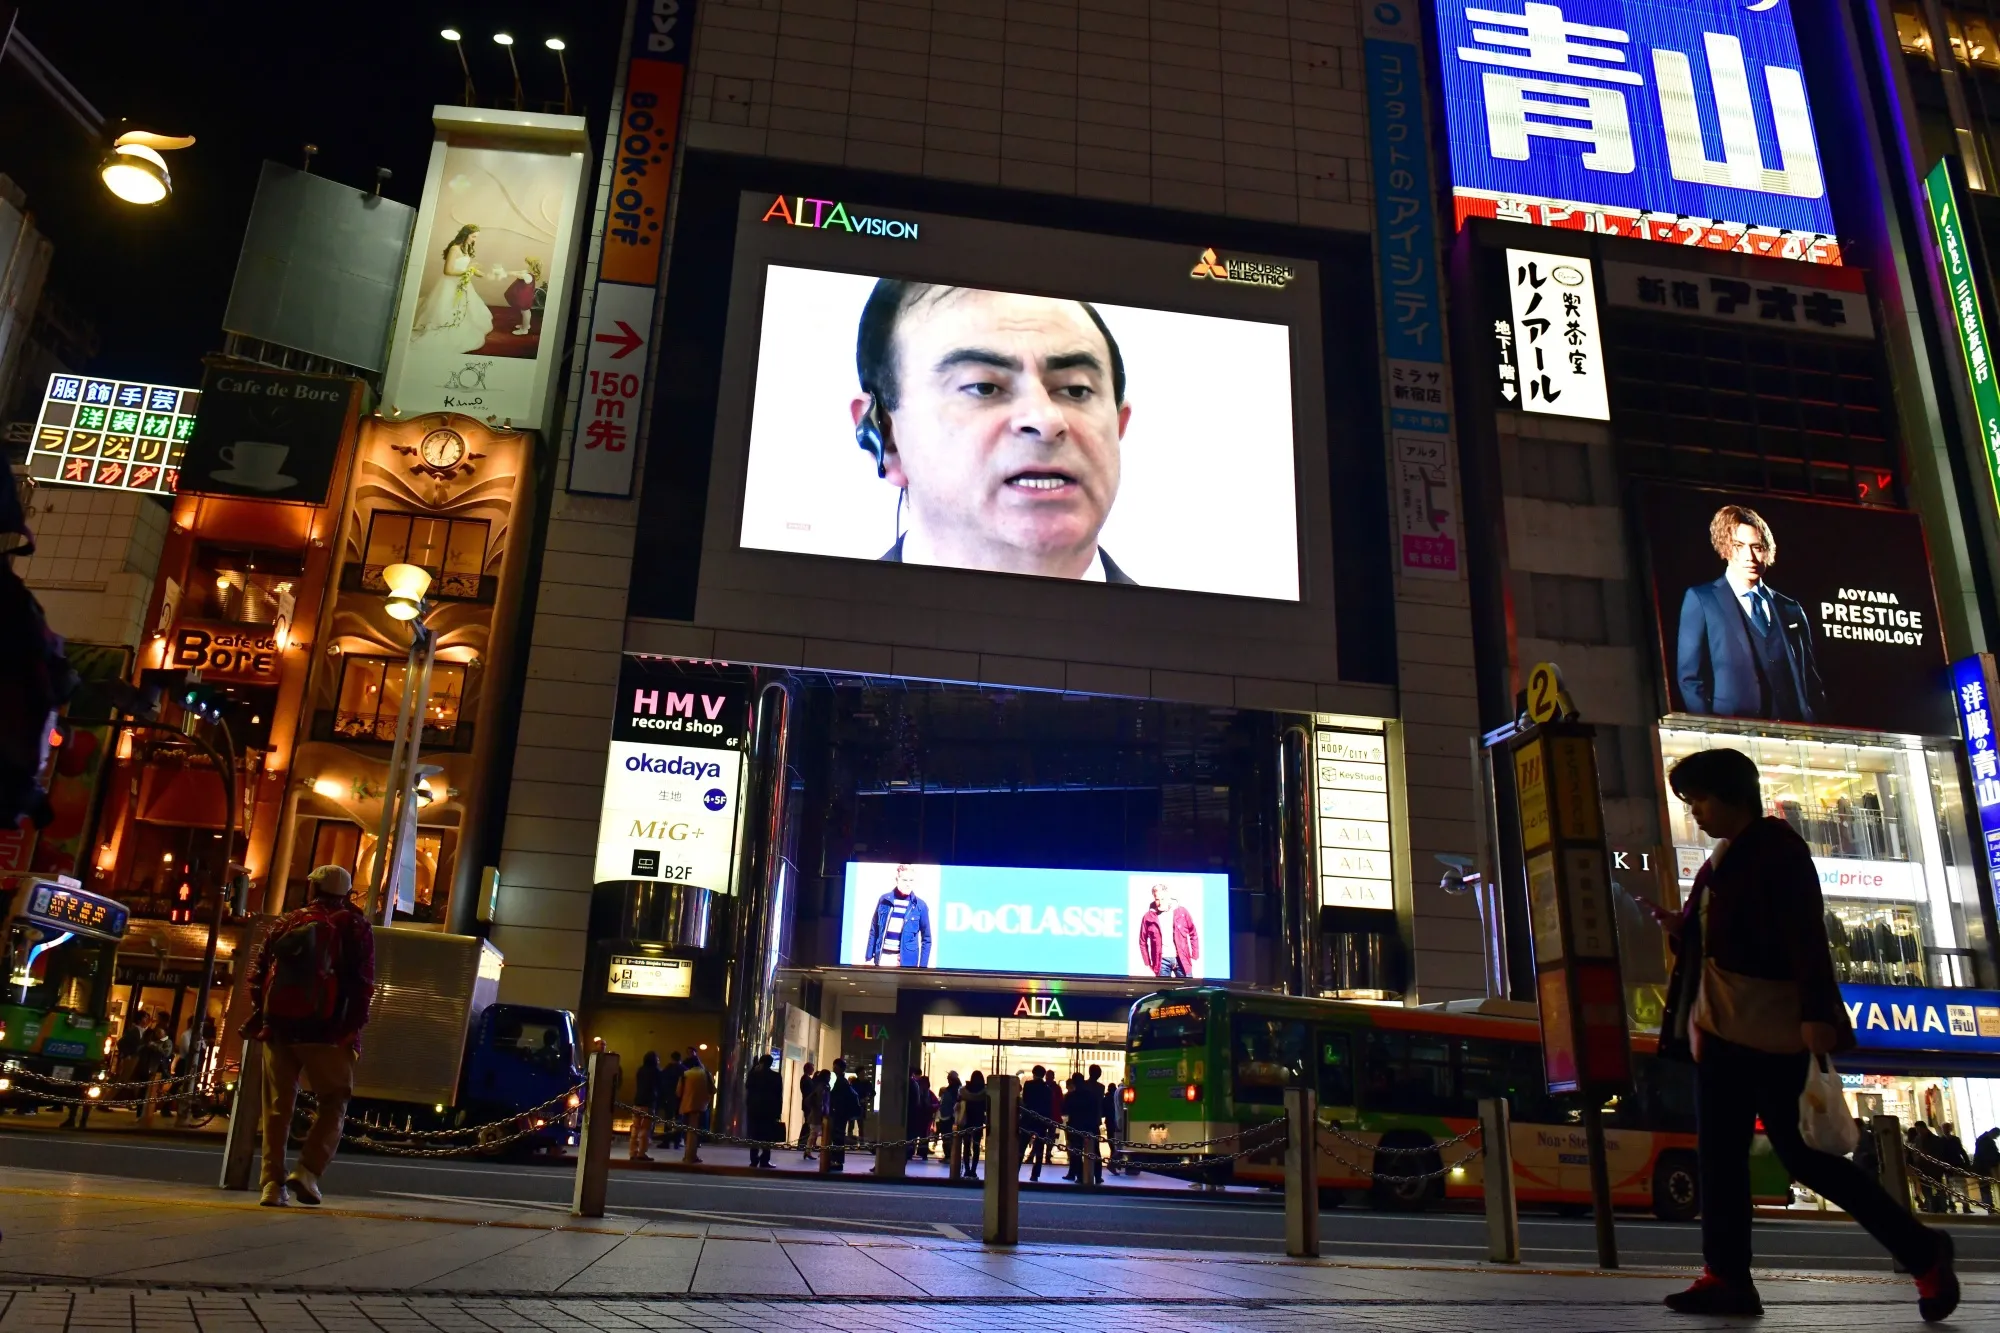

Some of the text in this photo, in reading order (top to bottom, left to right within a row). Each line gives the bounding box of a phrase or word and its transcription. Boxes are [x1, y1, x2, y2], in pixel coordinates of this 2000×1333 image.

[1456, 2, 1824, 199] 青山
[1380, 54, 1430, 345] コンタクトのアイシティ
[1944, 225, 1963, 275] SMBC
[1228, 270, 1285, 285] ELECTRIC
[1229, 259, 1293, 277] MITSUBISHI
[1518, 261, 1562, 404] ルノアール
[1563, 292, 1587, 375] 喫茶室
[1956, 278, 1989, 385] 三井住友銀行
[1494, 320, 1516, 381] 地下1階
[52, 378, 177, 411] 服飾手芸
[216, 377, 340, 402] Cafe de Bore
[1406, 446, 1438, 458] アルタ
[1838, 588, 1900, 605] AOYAMA
[1820, 602, 1923, 630] PRESTIGE
[214, 633, 277, 651] cafe de
[1822, 623, 1924, 646] TECHNOLOGY
[632, 687, 726, 721] HMV
[1533, 669, 1551, 717] 2
[631, 715, 724, 738] record shop
[726, 737, 739, 747] 6F
[1961, 681, 2000, 807] 洋服の青山
[625, 752, 721, 781] okadaya
[658, 789, 683, 803] 生地
[665, 865, 693, 880] B2F
[944, 902, 1123, 938] DoCLASSE
[1013, 996, 1064, 1018] ALTA
[1844, 1001, 1946, 1033] YAMA
[851, 1024, 890, 1040] ALTA
[1951, 1018, 1974, 1033] 青山
